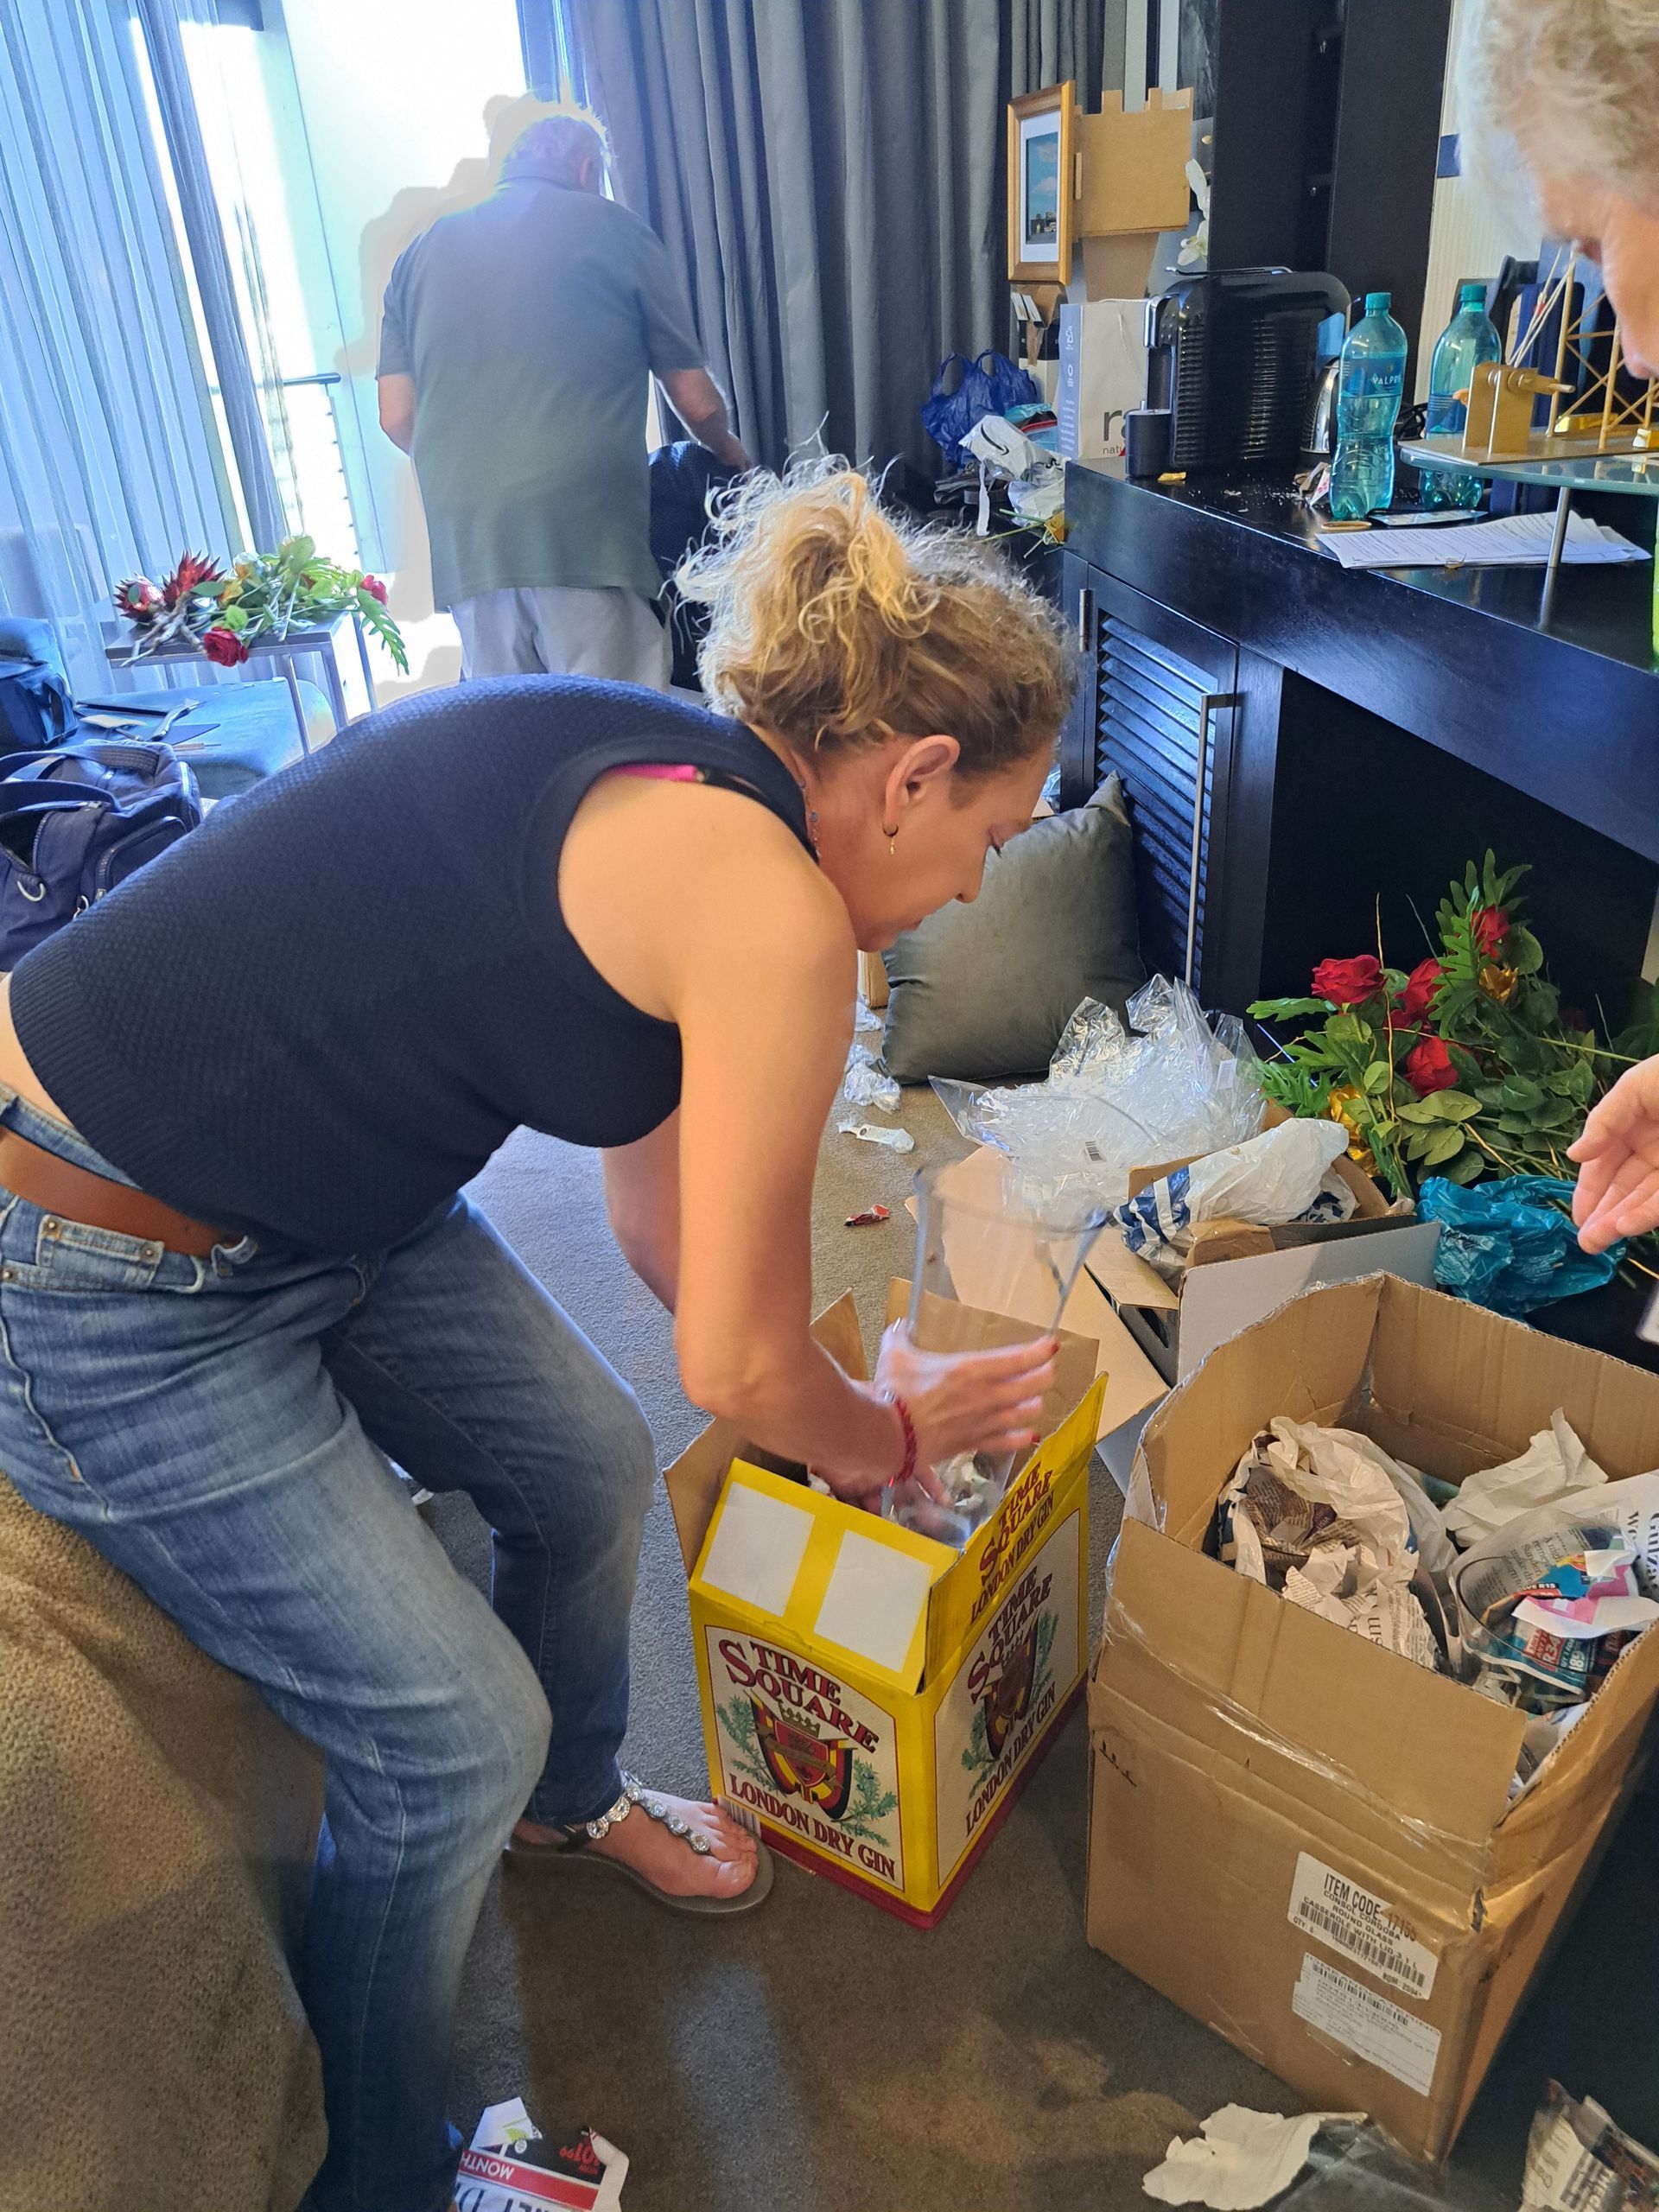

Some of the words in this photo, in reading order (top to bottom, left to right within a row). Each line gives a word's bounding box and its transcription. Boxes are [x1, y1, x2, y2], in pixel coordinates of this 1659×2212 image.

[979, 1469, 1053, 1586] SQUARE
[999, 1460, 1041, 1529] TIME
[969, 1547, 1016, 1624] LONDON
[1016, 1518, 1036, 1560] DRY
[1037, 1490, 1054, 1529] GIN
[967, 1573, 1053, 1705] SQUARE
[988, 1565, 1037, 1646] TIME
[718, 1639, 880, 1754] SQUARE
[749, 1641, 841, 1705] TIME
[965, 1747, 1013, 1838] LONDON
[1014, 1712, 1036, 1764] DRY
[1036, 1681, 1056, 1725] GIN
[729, 1773, 810, 1835] LONDON
[813, 1818, 855, 1858] DRY
[858, 1844, 895, 1881] GIN
[1324, 1872, 1351, 1901] ITEM
[1324, 1890, 1356, 1915] CONSOL
[1359, 1912, 1401, 1941] CORDOBA
[1303, 1896, 1351, 1929] CASSEROLE
[1353, 1927, 1376, 1945] WITH
[1379, 1942, 1394, 1955] LID
[1332, 1904, 1363, 1927] ROUND
[1365, 1925, 1393, 1946] GLASS
[458, 2152, 515, 2181] MONTH
